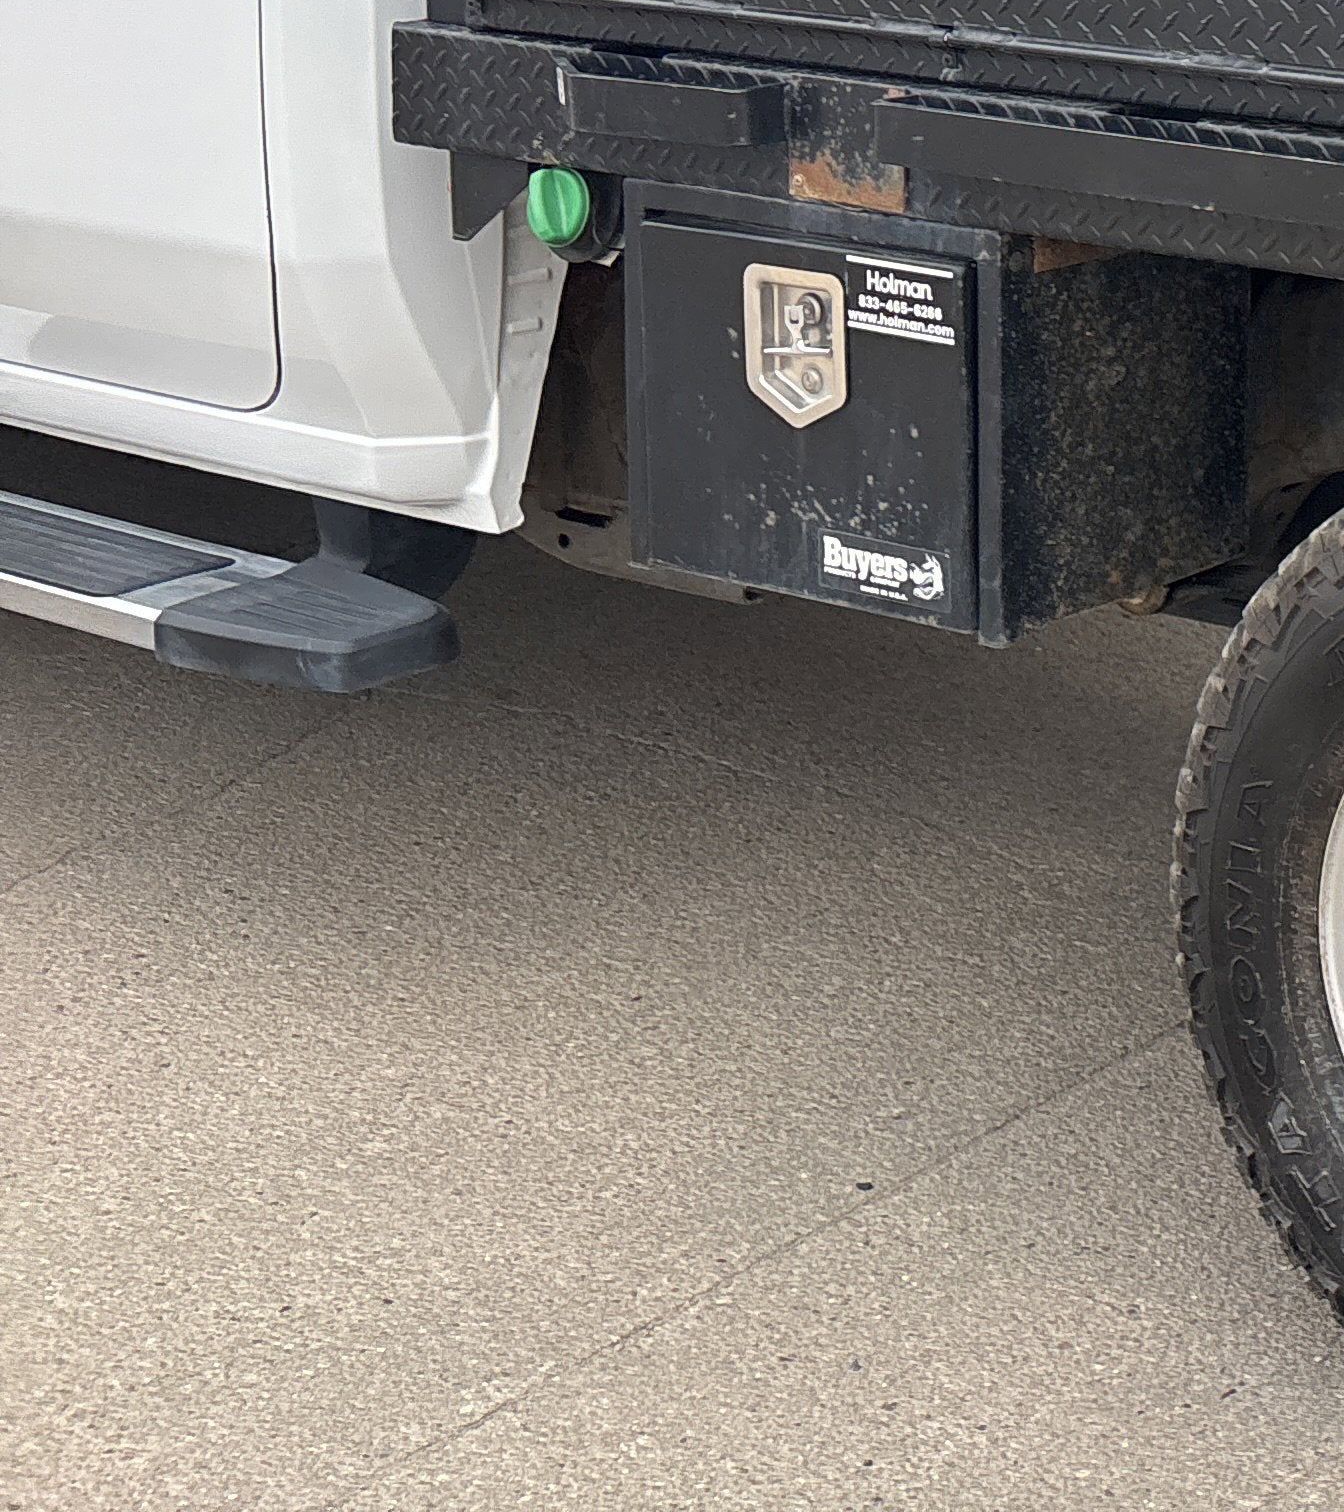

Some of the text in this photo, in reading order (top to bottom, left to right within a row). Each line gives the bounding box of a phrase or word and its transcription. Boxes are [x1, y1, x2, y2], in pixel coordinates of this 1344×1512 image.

[866, 269, 934, 301] Holman
[847, 309, 955, 338] www.holman.com
[823, 535, 908, 582] Buyers
